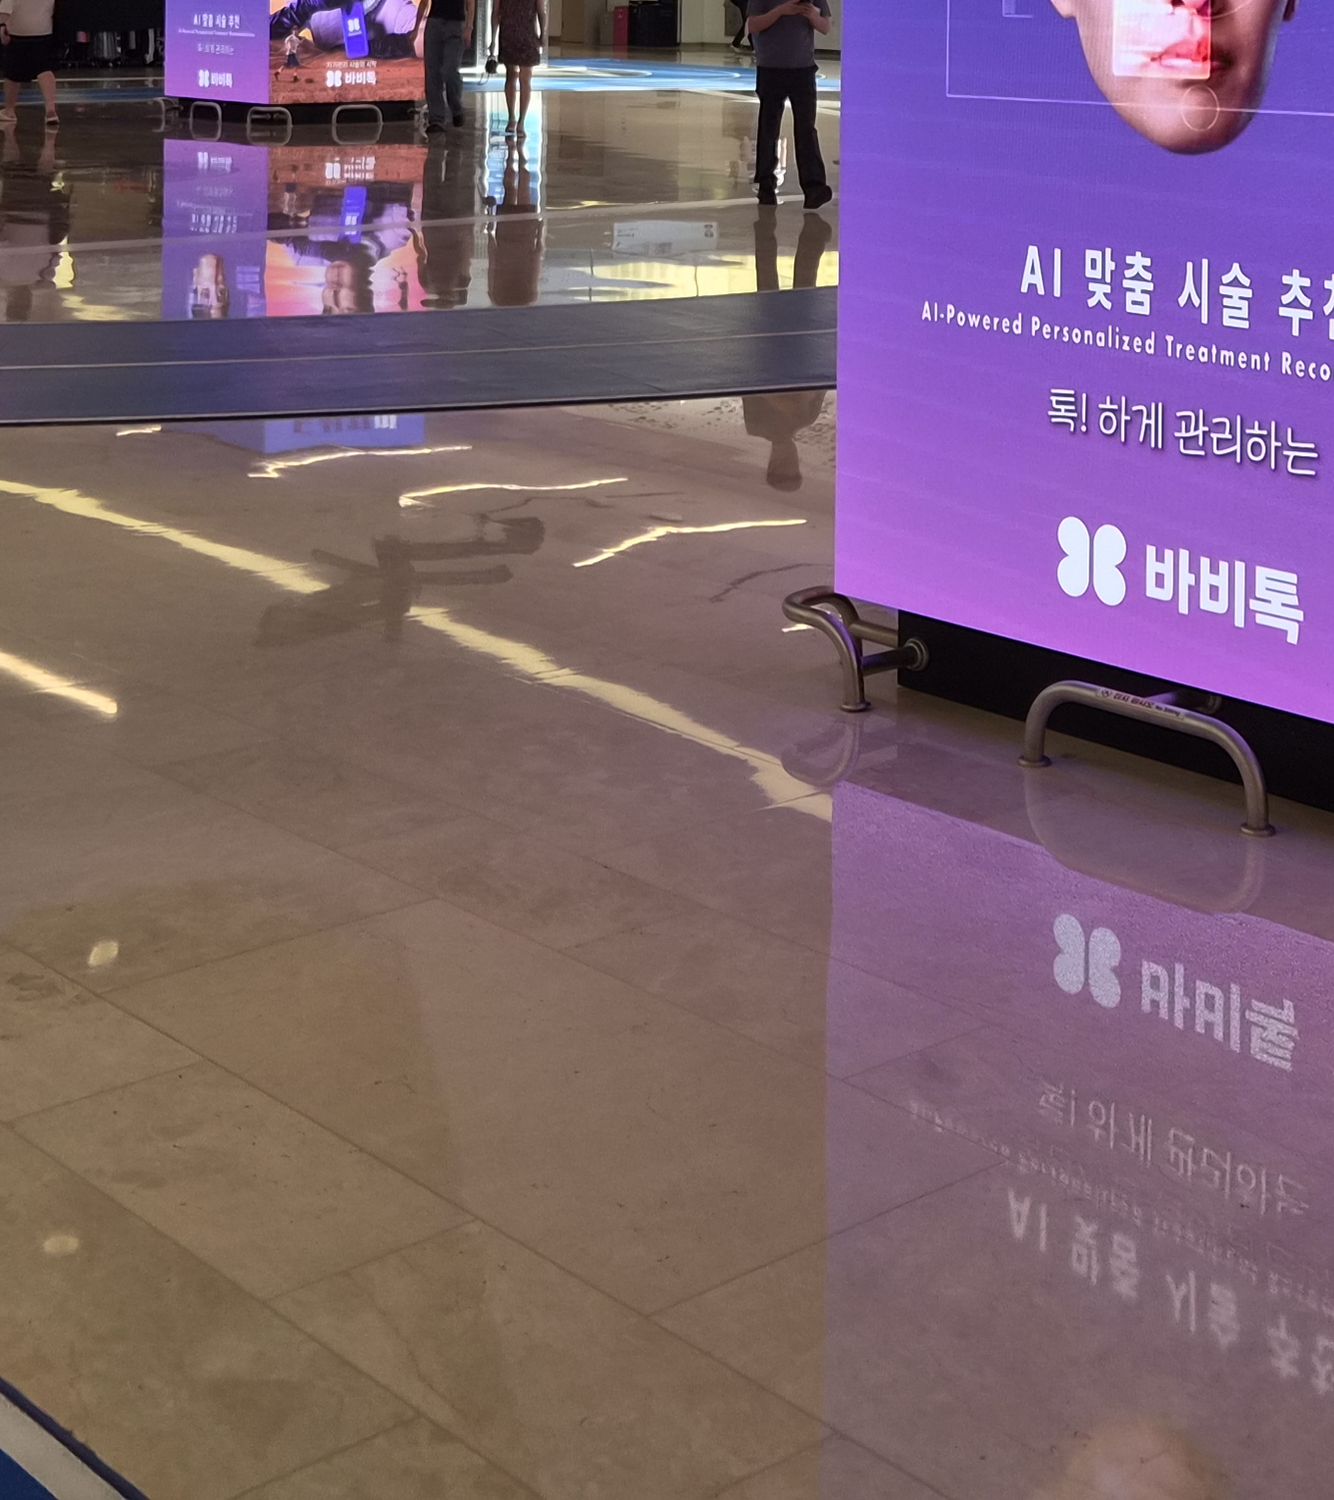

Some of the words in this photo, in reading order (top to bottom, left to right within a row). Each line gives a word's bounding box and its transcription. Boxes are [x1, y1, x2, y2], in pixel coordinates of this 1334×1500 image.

[1020, 245, 1062, 298] AI
[1084, 247, 1154, 316] 맞춤
[1177, 258, 1253, 329] 시술
[921, 300, 1023, 335] AI-Powered
[1031, 315, 1155, 355] Personalized
[1165, 335, 1271, 372] Treatment
[1047, 388, 1088, 433] 톡!
[1098, 395, 1164, 450] 하게
[1173, 408, 1319, 476] 관리하는
[1145, 544, 1304, 646] 바비톡
